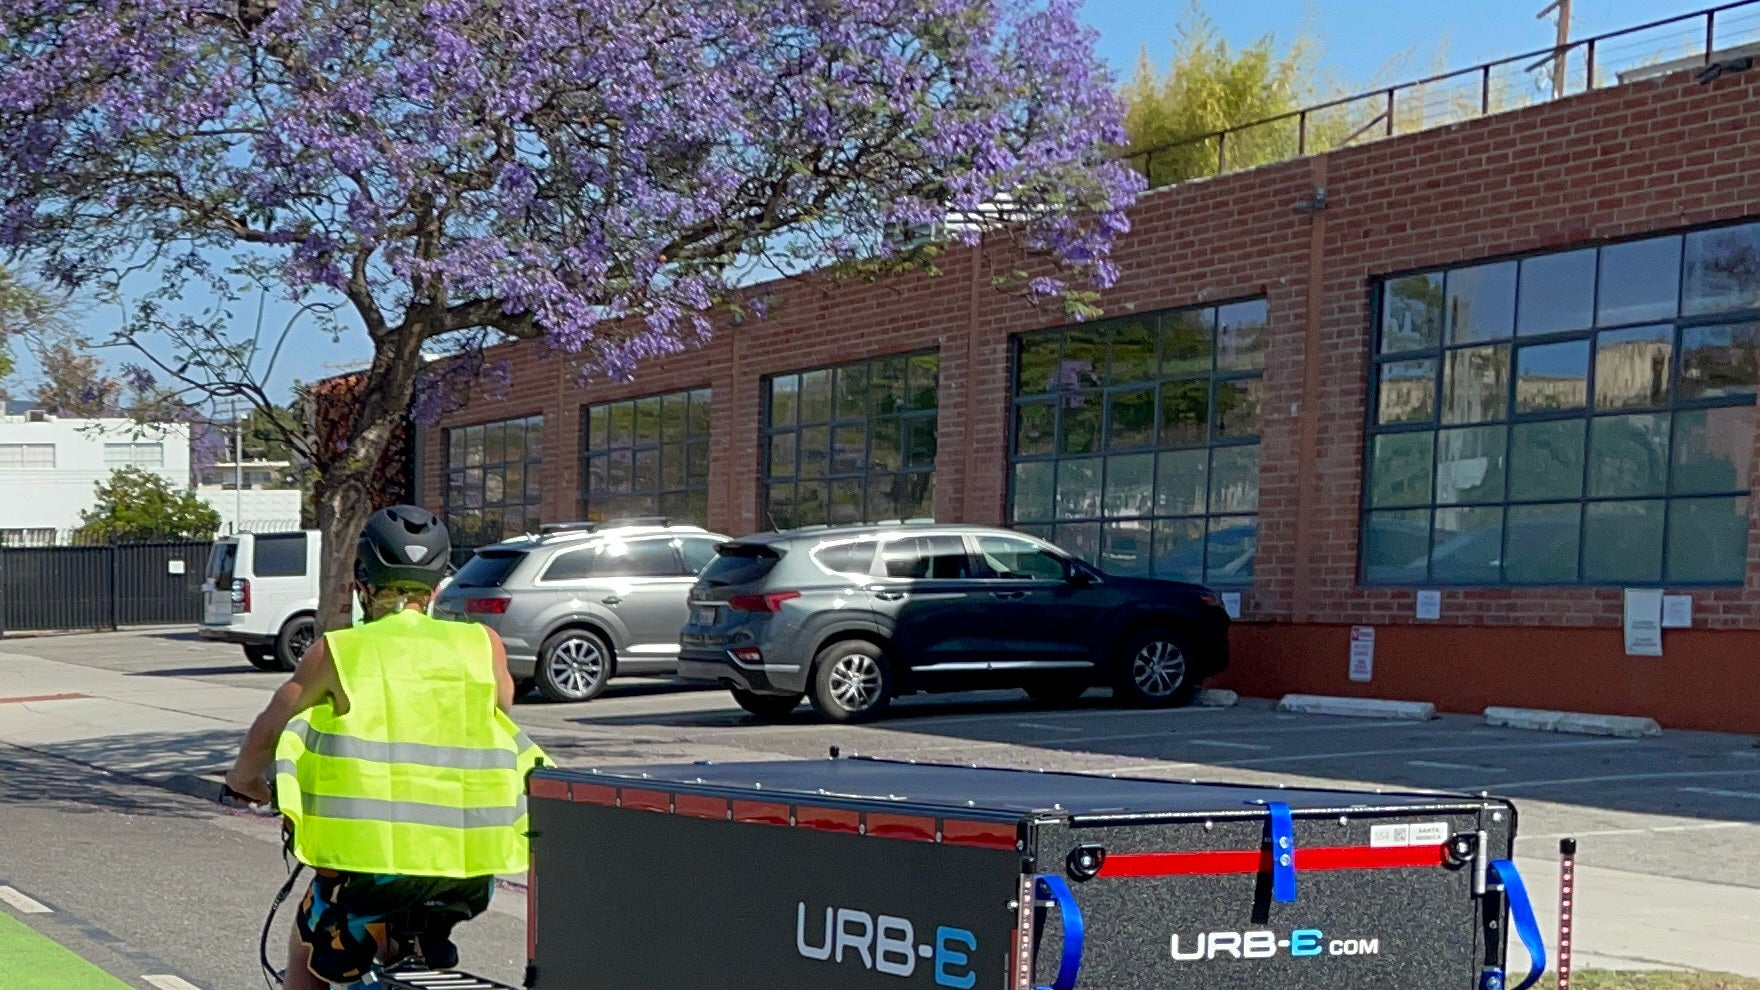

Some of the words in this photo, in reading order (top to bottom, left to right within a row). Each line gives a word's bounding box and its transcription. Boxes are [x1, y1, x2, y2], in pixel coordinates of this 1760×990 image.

[796, 901, 978, 990] URB-E
[1171, 928, 1324, 961] URB-E
[1329, 938, 1379, 956] COM
